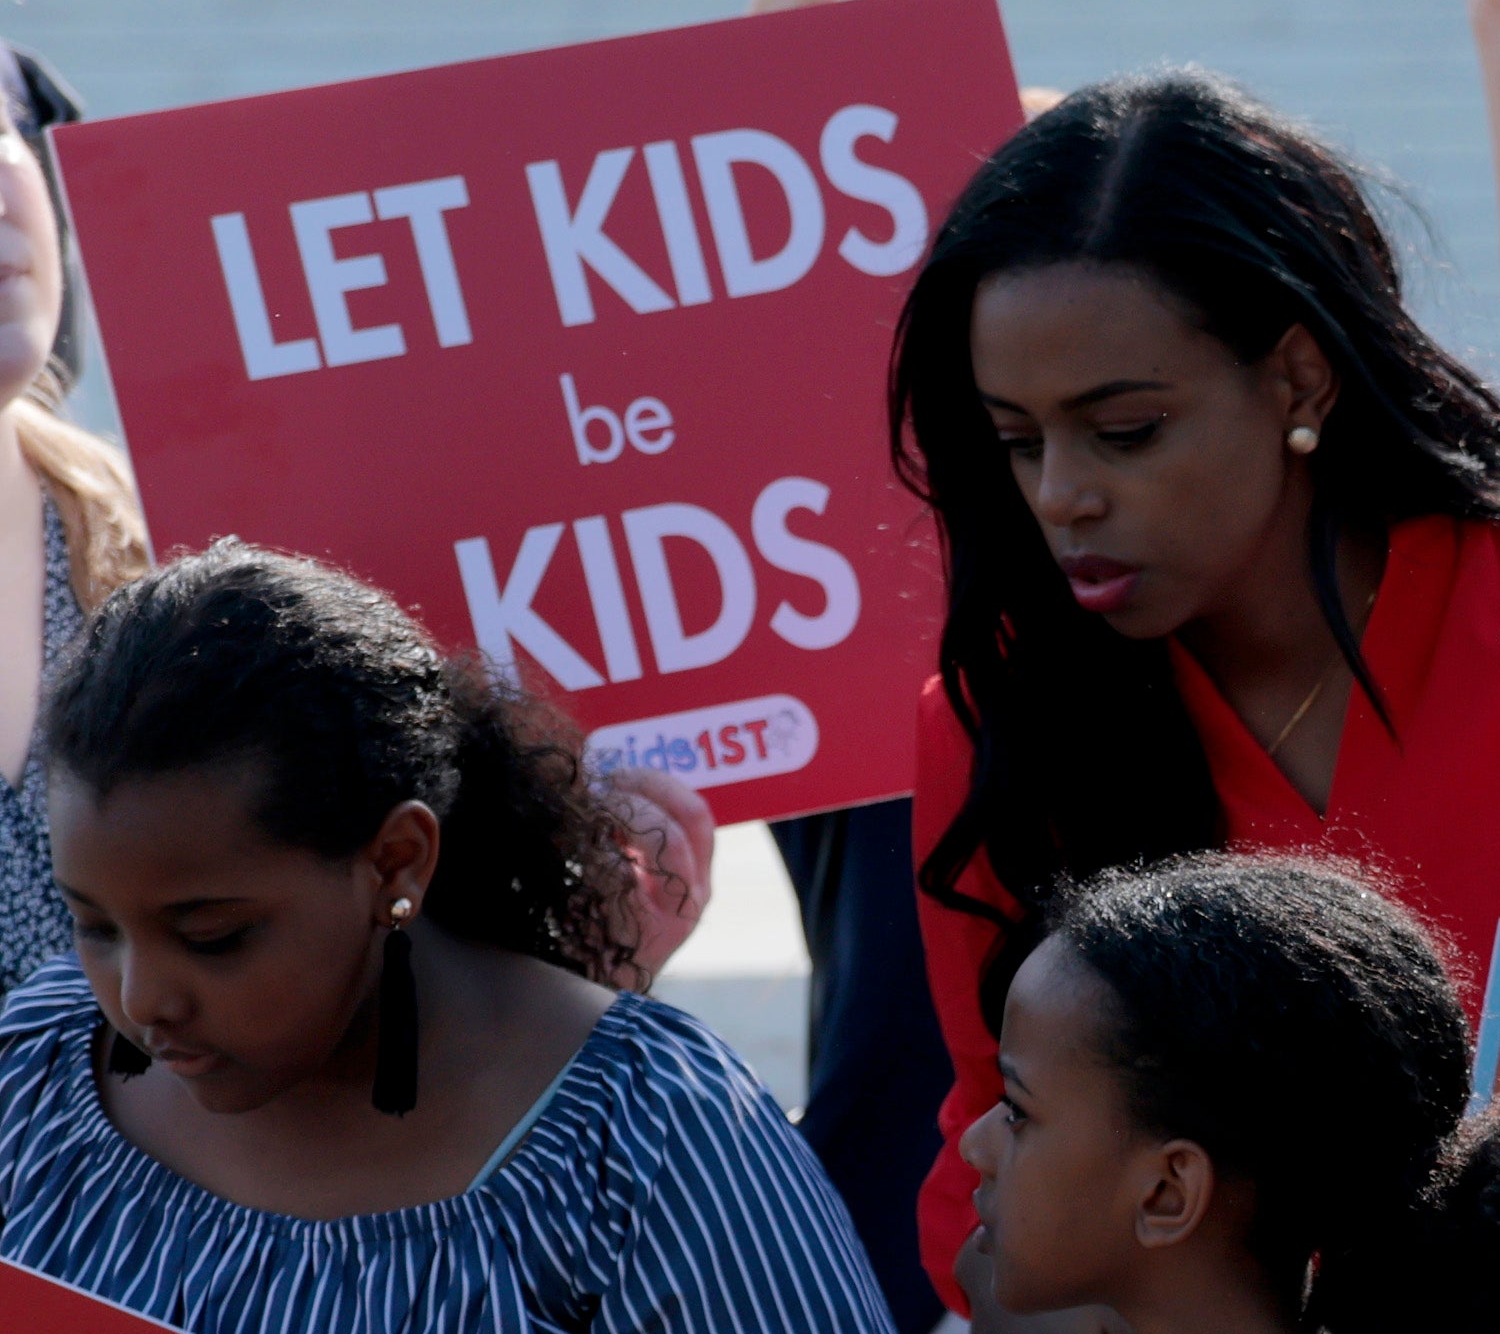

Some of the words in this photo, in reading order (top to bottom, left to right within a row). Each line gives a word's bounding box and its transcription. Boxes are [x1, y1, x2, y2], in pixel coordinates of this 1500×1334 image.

[211, 175, 472, 380] LET
[525, 104, 928, 327] KIDS
[560, 373, 674, 465] be
[454, 478, 861, 702] KIDS
